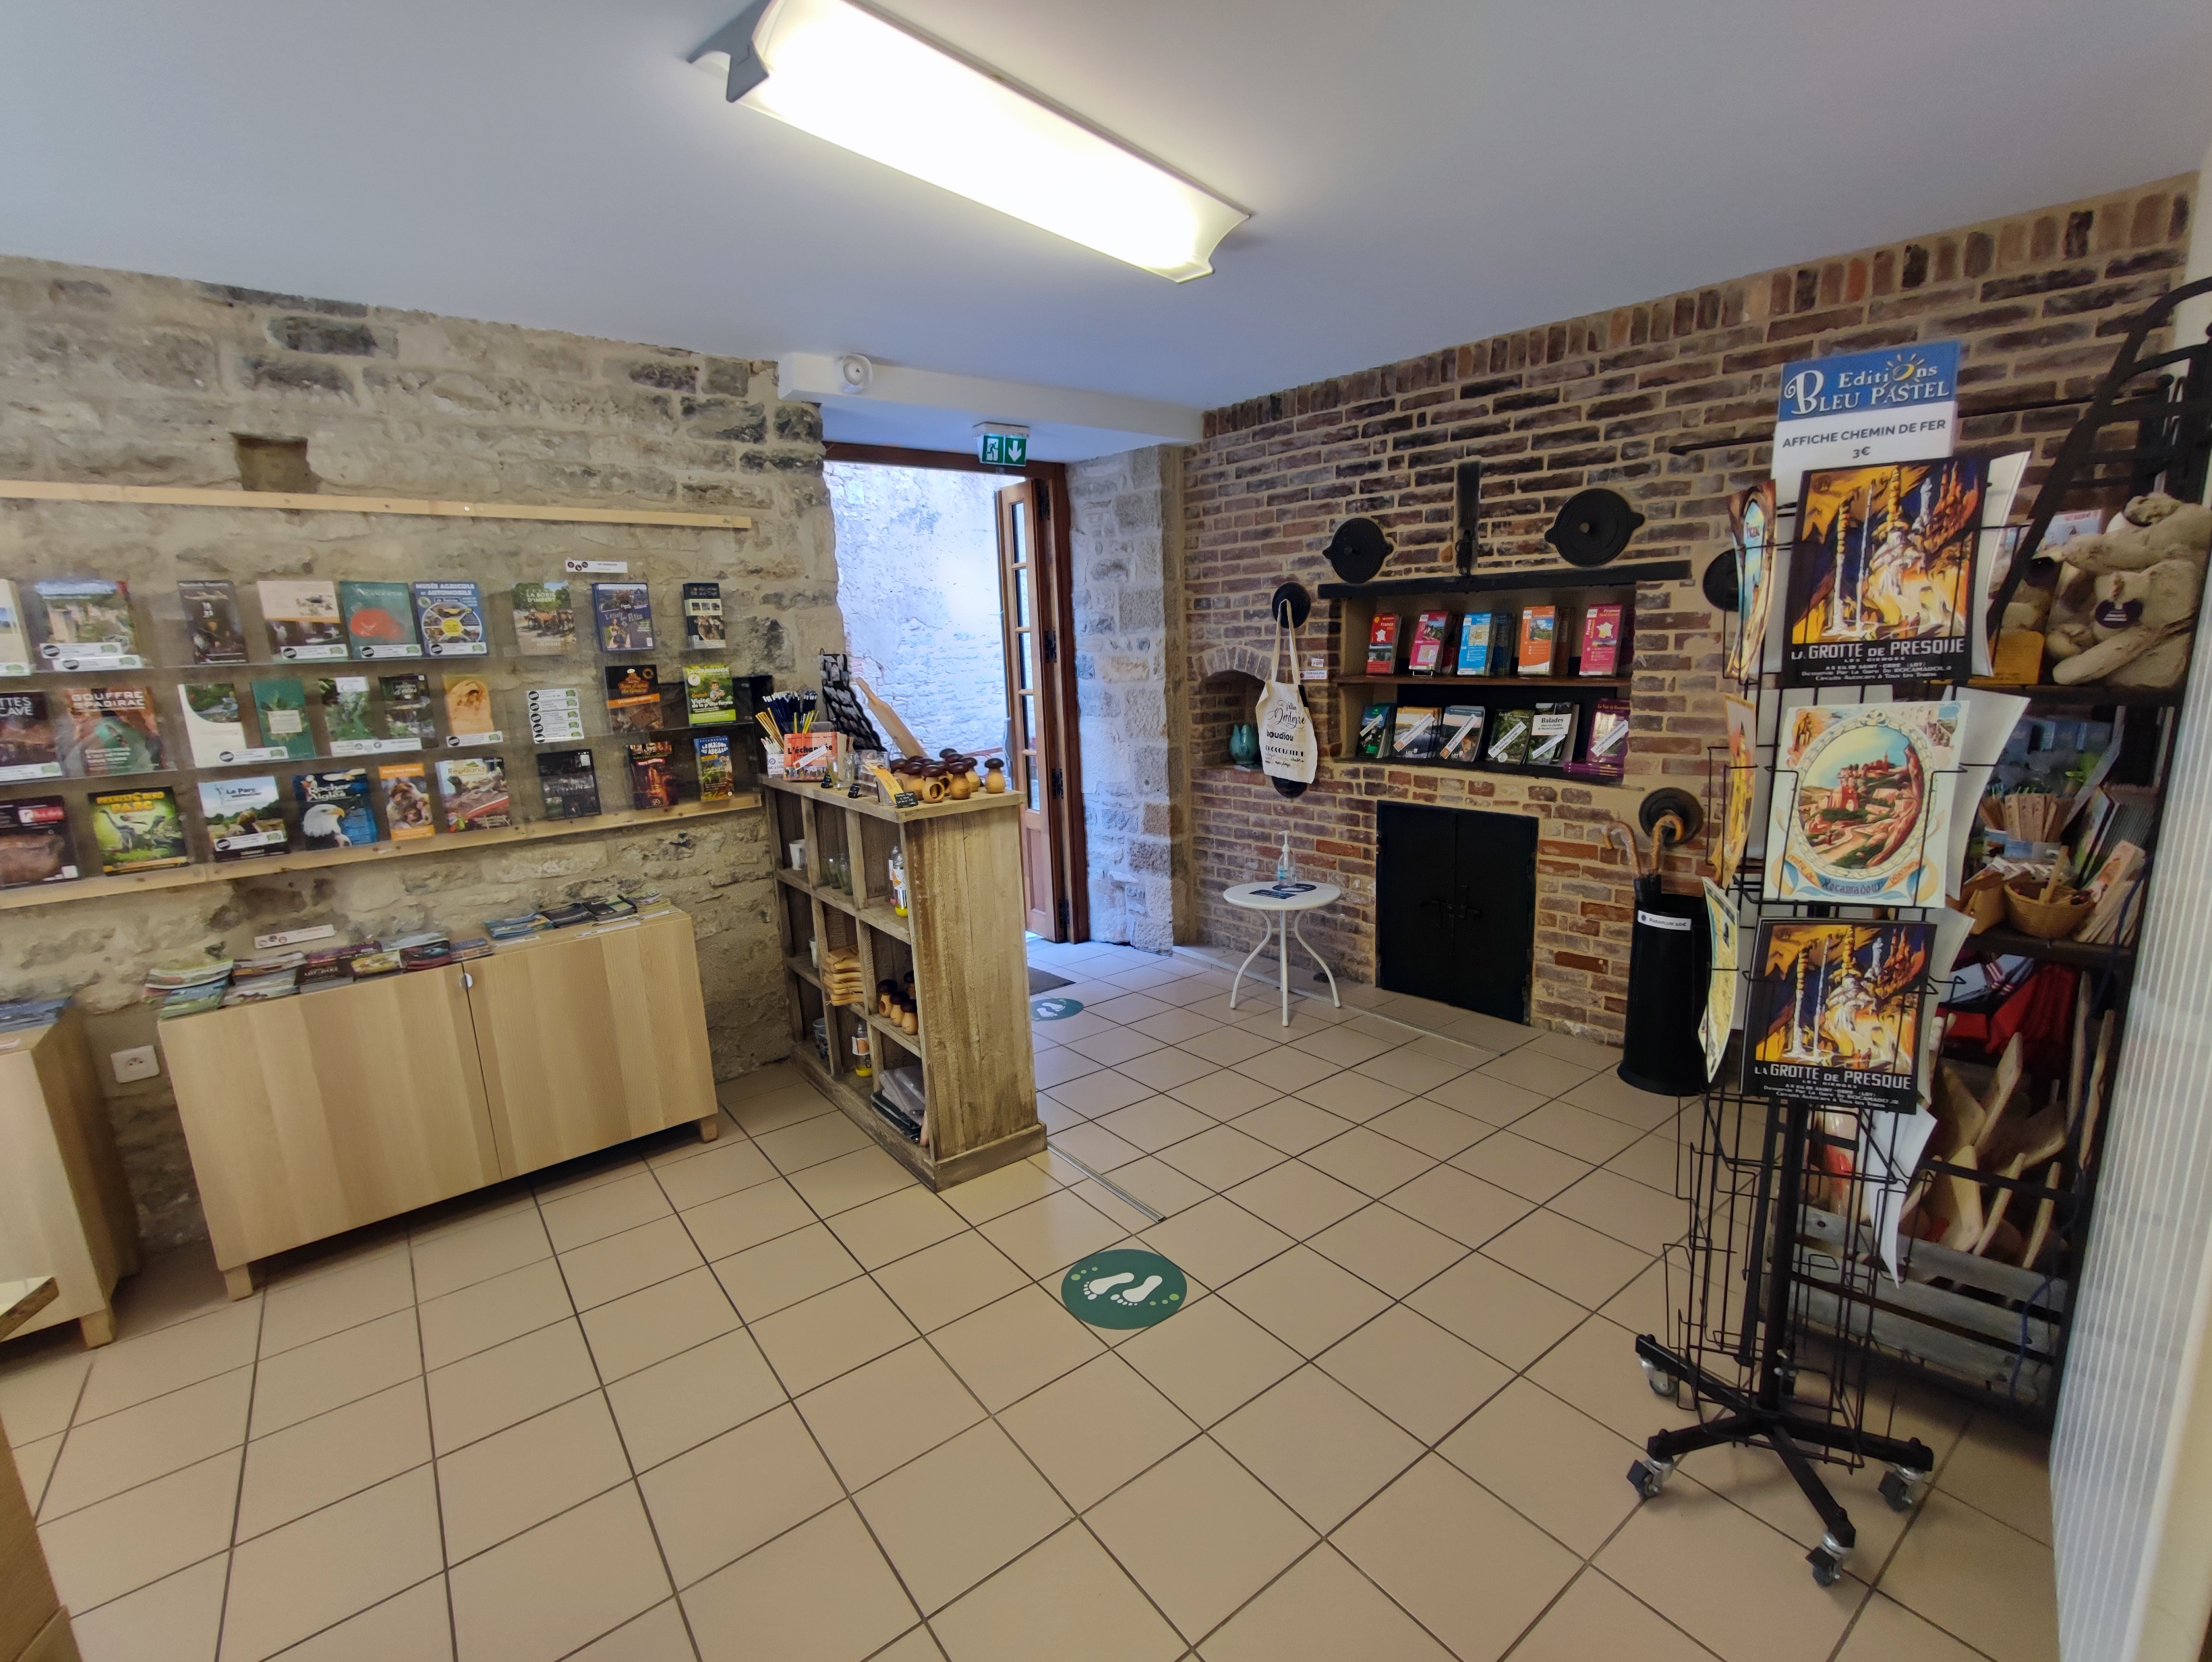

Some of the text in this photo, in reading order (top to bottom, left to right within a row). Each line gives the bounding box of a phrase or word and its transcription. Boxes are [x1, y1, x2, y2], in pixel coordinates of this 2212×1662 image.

[1784, 370, 1949, 414] BLEU PASTEL
[1782, 419, 1946, 449] AFFICHE CHEMIN DE FER
[1852, 446, 1871, 459] 3€
[1809, 643, 1863, 660] GROTTE
[1867, 647, 1886, 657] DE
[1890, 638, 1965, 656] PRESQUE
[71, 691, 145, 701] GOUFFRE
[448, 766, 485, 775] Reptiland
[308, 782, 351, 795] Rocher
[1822, 878, 1883, 894] Rocamadour
[1755, 1063, 1911, 1090] LA GROTTE DE PRESQUE
